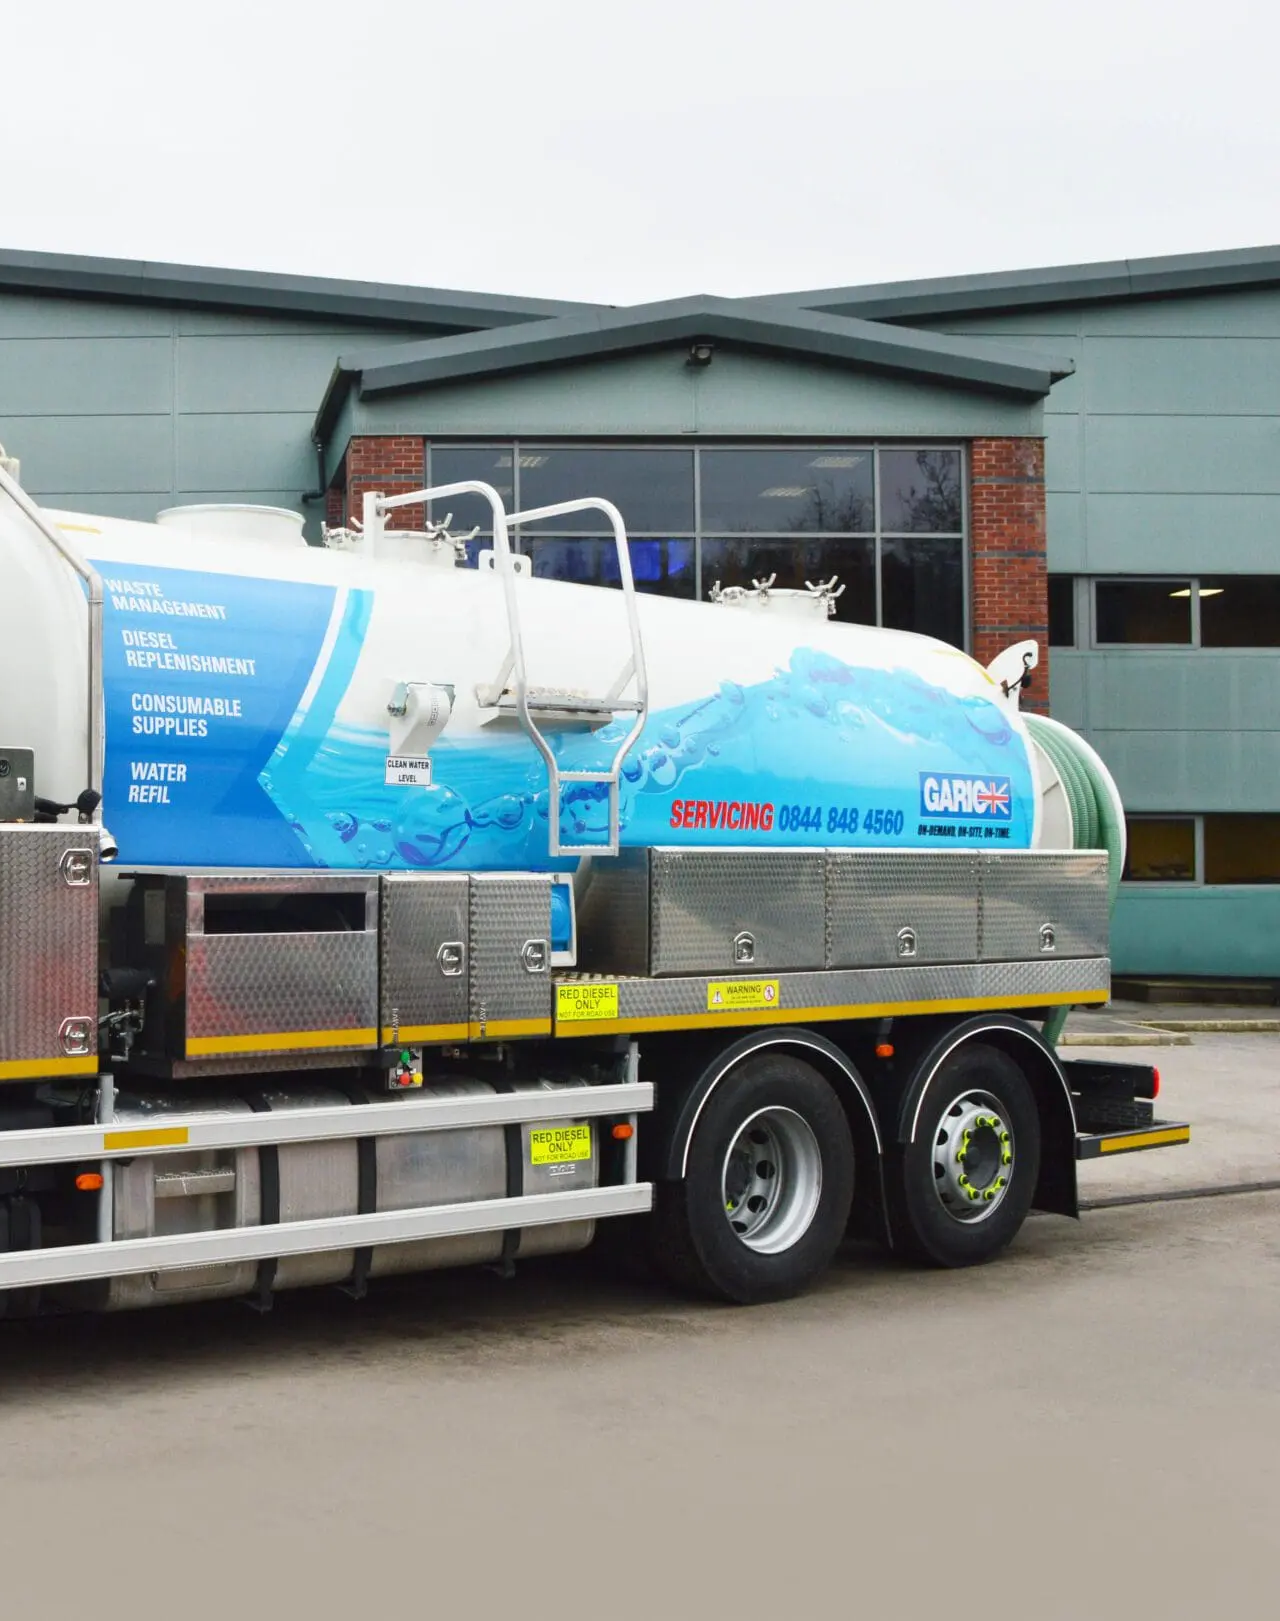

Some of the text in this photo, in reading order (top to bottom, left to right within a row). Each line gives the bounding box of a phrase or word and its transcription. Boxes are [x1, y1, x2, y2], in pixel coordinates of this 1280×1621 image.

[104, 579, 163, 597] WASTE
[111, 595, 226, 620] MANAGEMENT
[121, 629, 178, 650] DIESEL
[125, 649, 256, 675] REPLENISHMENT
[131, 692, 242, 717] CONSUMABLE
[132, 715, 208, 738] SUPPLIES
[130, 762, 187, 782] WATER
[387, 760, 430, 770] CLEAN WATER
[398, 774, 417, 783] LEVEL
[128, 784, 171, 804] REFIL
[923, 777, 989, 814] GARIC
[669, 800, 905, 836] SERVICING 0844 848 4560
[559, 987, 616, 999] RED DIESEL
[726, 984, 761, 995] WARNING
[575, 999, 601, 1010] ONLY
[532, 1128, 588, 1144] RED DIESEL
[548, 1141, 573, 1153] ONLY
